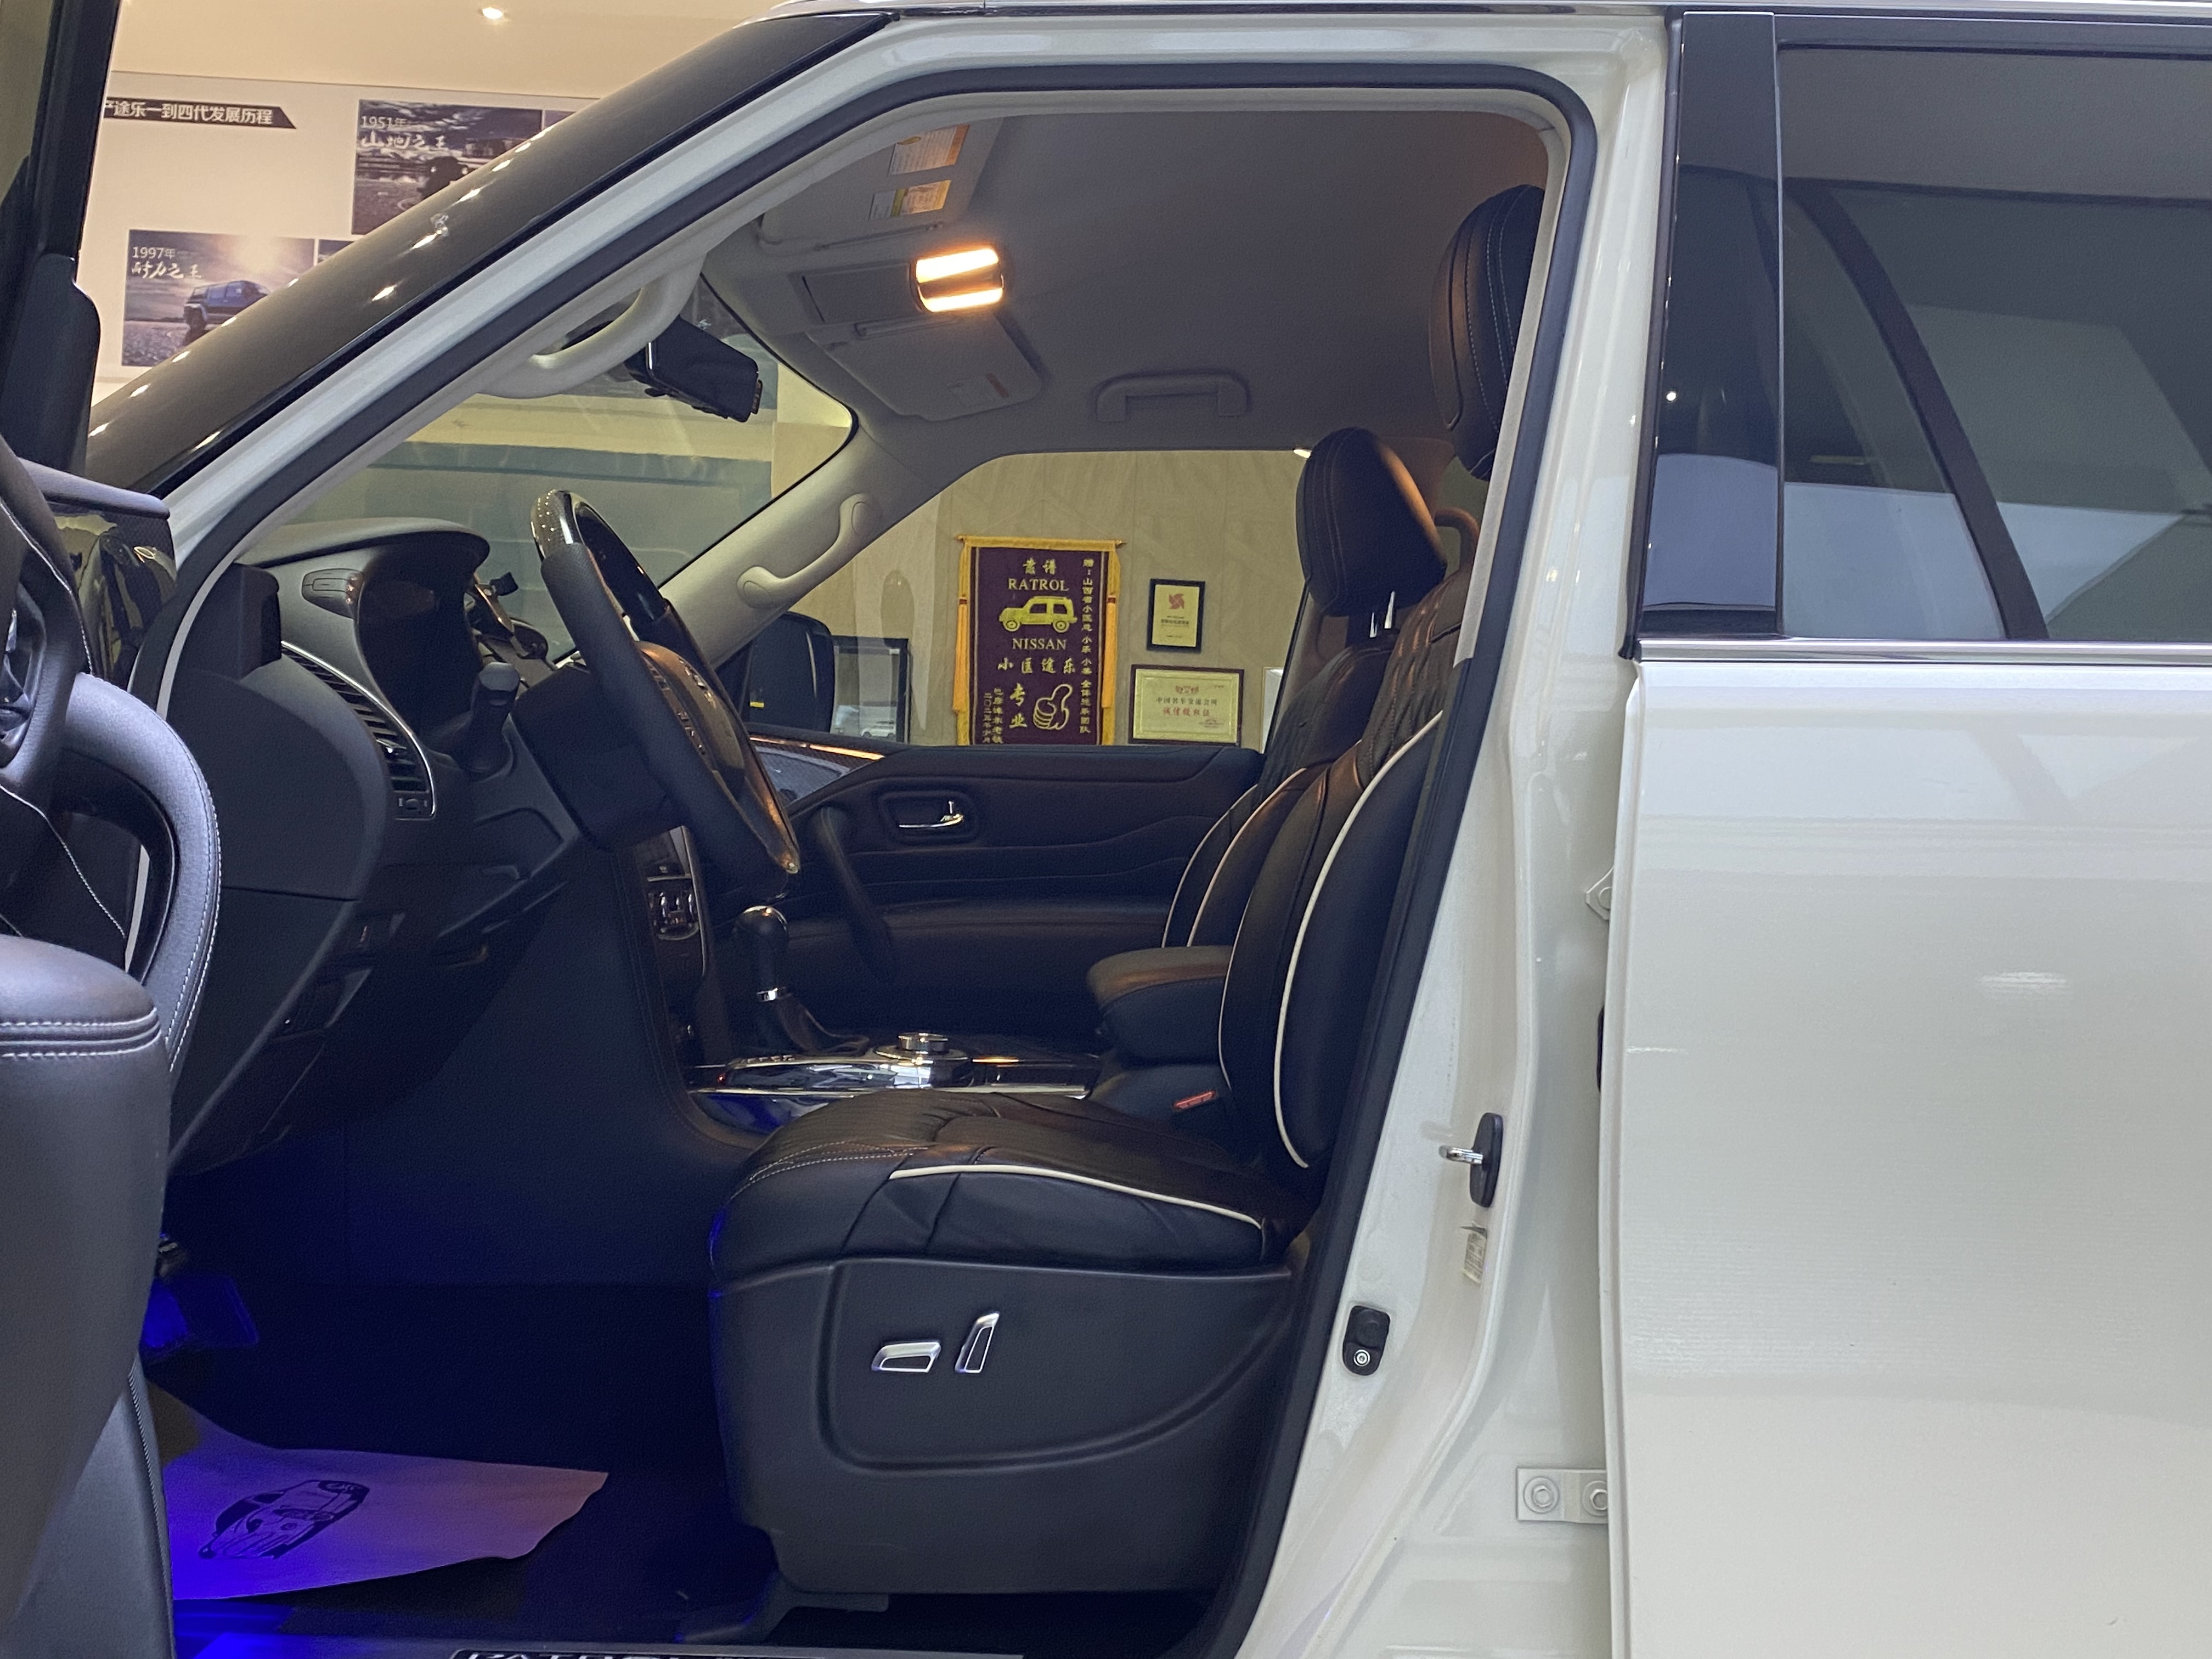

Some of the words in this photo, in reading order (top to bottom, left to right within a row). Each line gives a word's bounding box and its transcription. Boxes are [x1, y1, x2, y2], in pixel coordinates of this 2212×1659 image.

[361, 116, 407, 129] 1951年
[360, 130, 449, 151] 山地之王
[132, 246, 176, 259] 1997年
[131, 261, 202, 279] 耐力之王
[1008, 578, 1069, 591] RATROL
[1012, 638, 1067, 651] NISSAN
